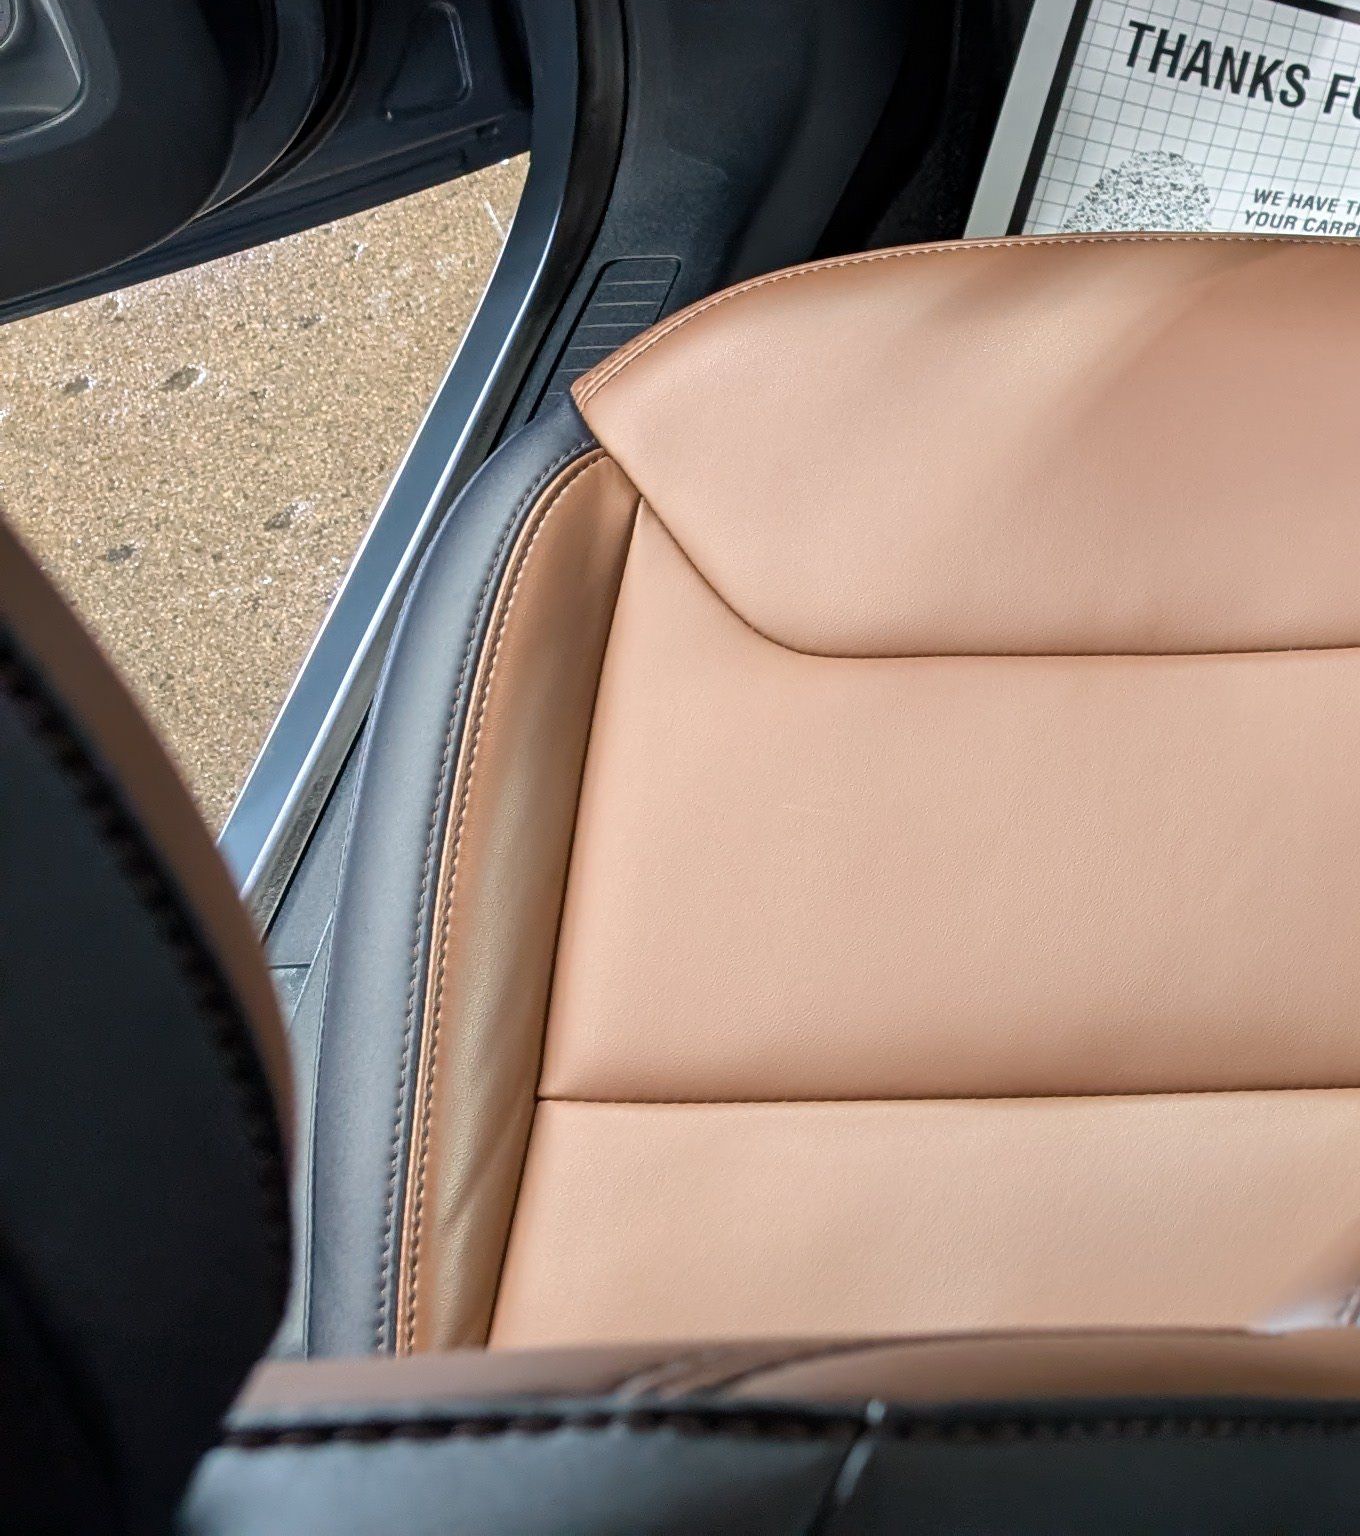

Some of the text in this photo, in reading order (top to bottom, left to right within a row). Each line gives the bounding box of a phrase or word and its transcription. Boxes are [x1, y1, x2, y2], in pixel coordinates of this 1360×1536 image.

[1126, 19, 1311, 108] THANKS
[1253, 188, 1285, 207] WE
[1287, 193, 1341, 214] HAVE
[1243, 209, 1299, 230] YOUR
